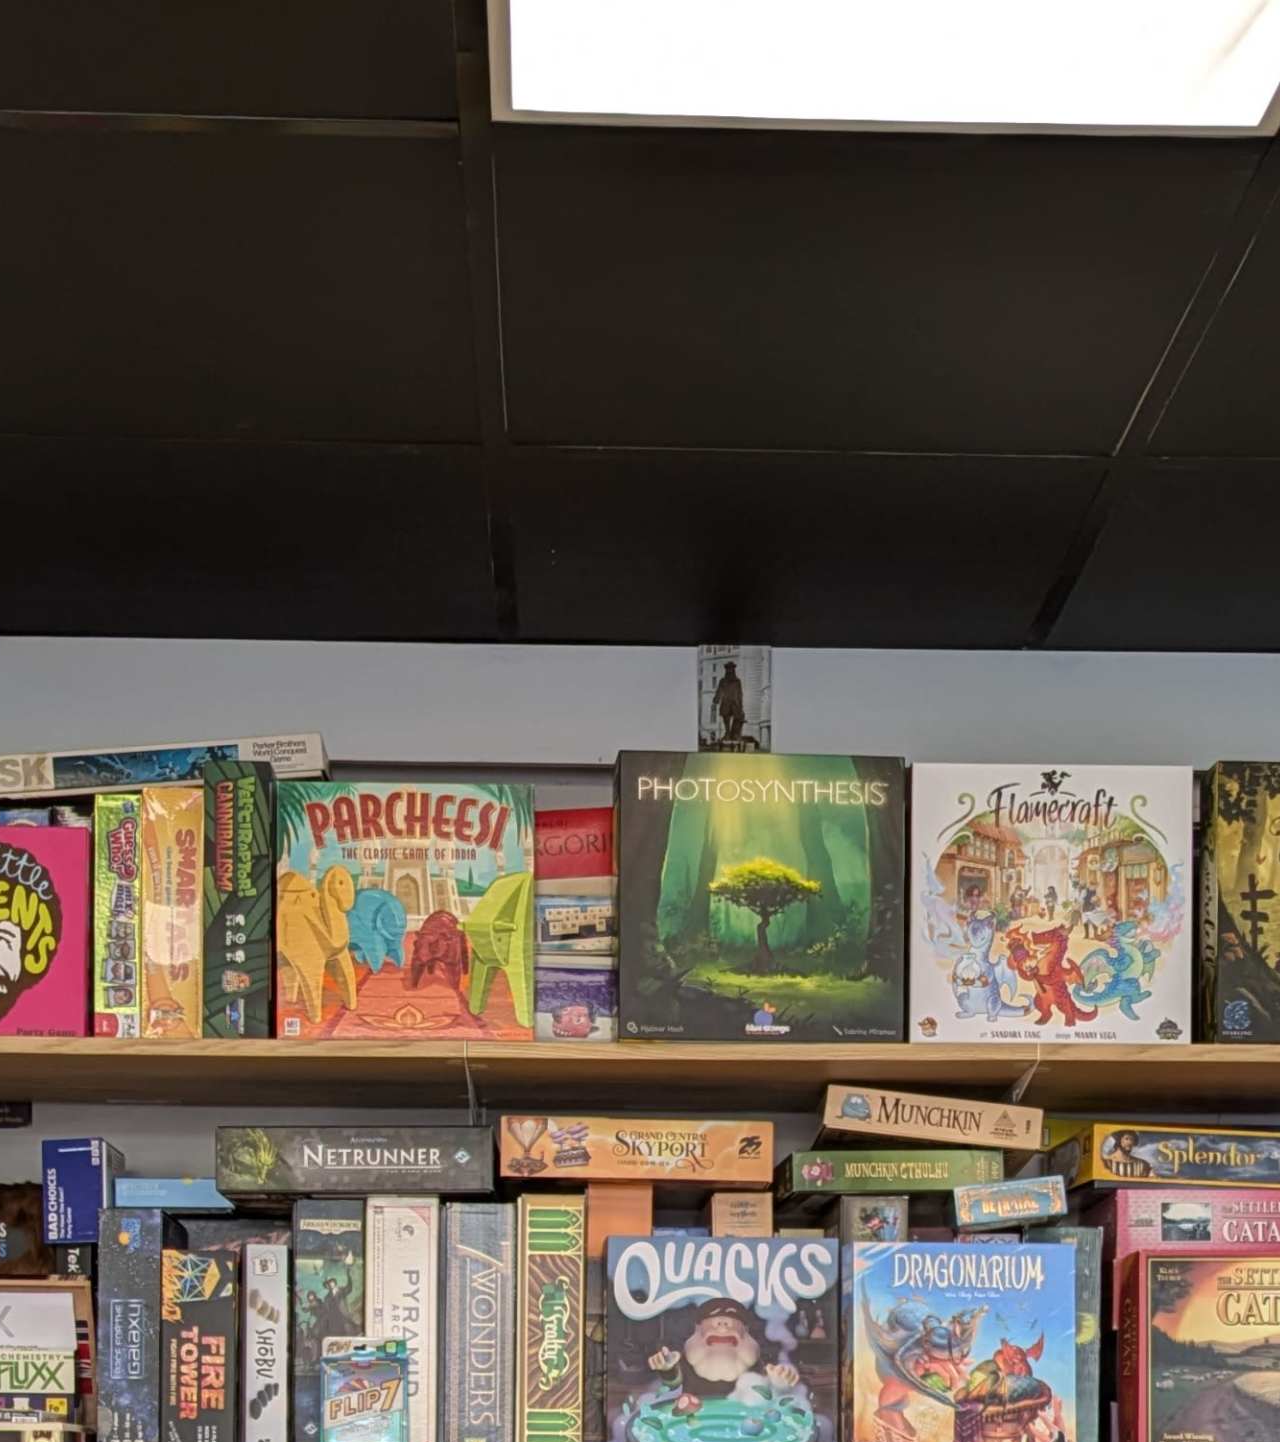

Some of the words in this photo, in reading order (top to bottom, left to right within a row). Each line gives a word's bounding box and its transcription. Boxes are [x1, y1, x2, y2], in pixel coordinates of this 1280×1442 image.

[637, 777, 886, 806] PHOTOSYNTHESIS
[987, 783, 1118, 828] Flamecraft
[304, 788, 513, 852] PARCHEESI
[342, 847, 359, 860] THE
[363, 847, 397, 860] CLASSIC
[401, 847, 429, 860] GAME
[434, 847, 446, 860] OF
[450, 847, 477, 861] INDIA
[876, 1096, 985, 1132] MUNCHKIN
[303, 1144, 441, 1168] NETRUNNER
[612, 1130, 710, 1160] SKYPORT
[1157, 1137, 1262, 1173] Splendor
[844, 1161, 898, 1178] MUNCHKIN
[47, 1168, 58, 1212] CHOICES
[48, 1214, 58, 1240] BAD
[614, 1241, 833, 1321] QUACKS
[892, 1252, 1045, 1292] DRAGONARIUM
[0, 1353, 63, 1361] CHEMISTRY
[470, 1267, 497, 1426] WONDERS
[178, 1326, 199, 1421] TOWER
[201, 1336, 226, 1410] FIRE
[329, 1390, 381, 1420] FLIP
[379, 1376, 402, 1411] 7
